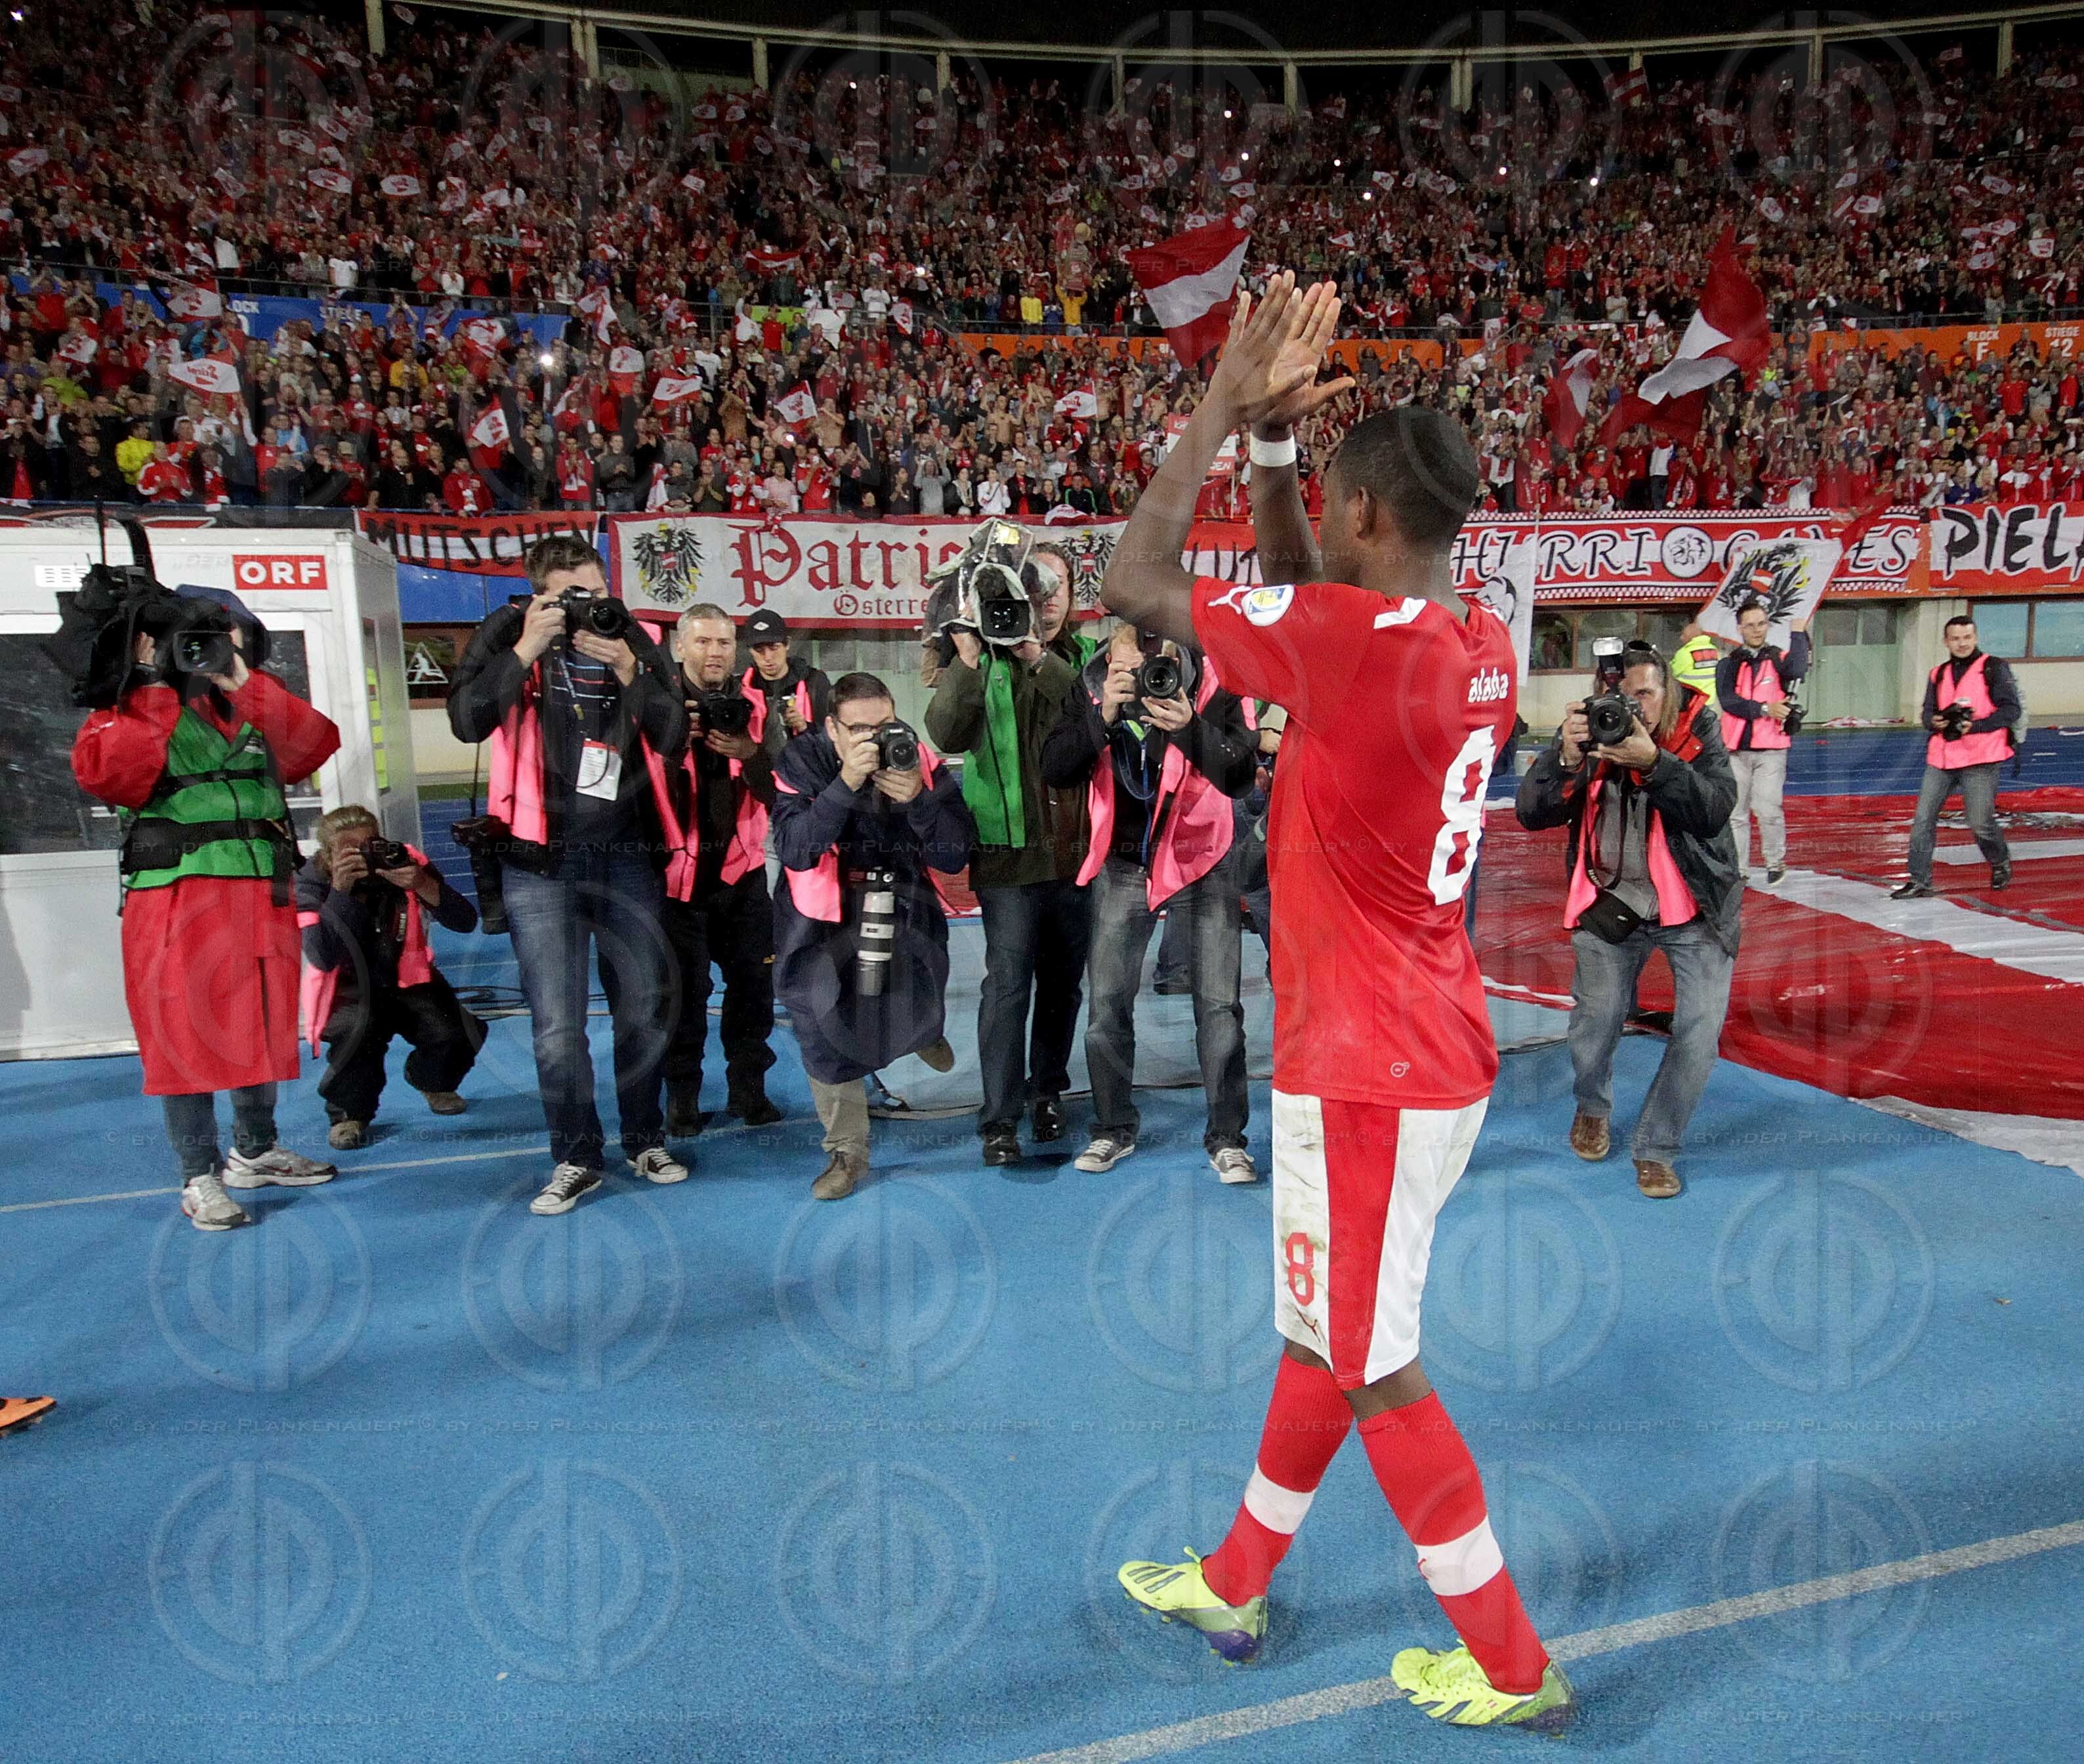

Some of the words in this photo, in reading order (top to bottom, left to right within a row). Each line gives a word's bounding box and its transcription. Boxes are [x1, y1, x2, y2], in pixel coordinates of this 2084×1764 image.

[1967, 330, 1999, 342] BLOCK
[2044, 327, 2080, 338] STIEGE
[1976, 342, 1989, 361] F
[240, 562, 321, 584] ORF
[1468, 667, 1509, 703] alaba
[1427, 724, 1496, 906] 8
[1285, 1232, 1314, 1306] 8
